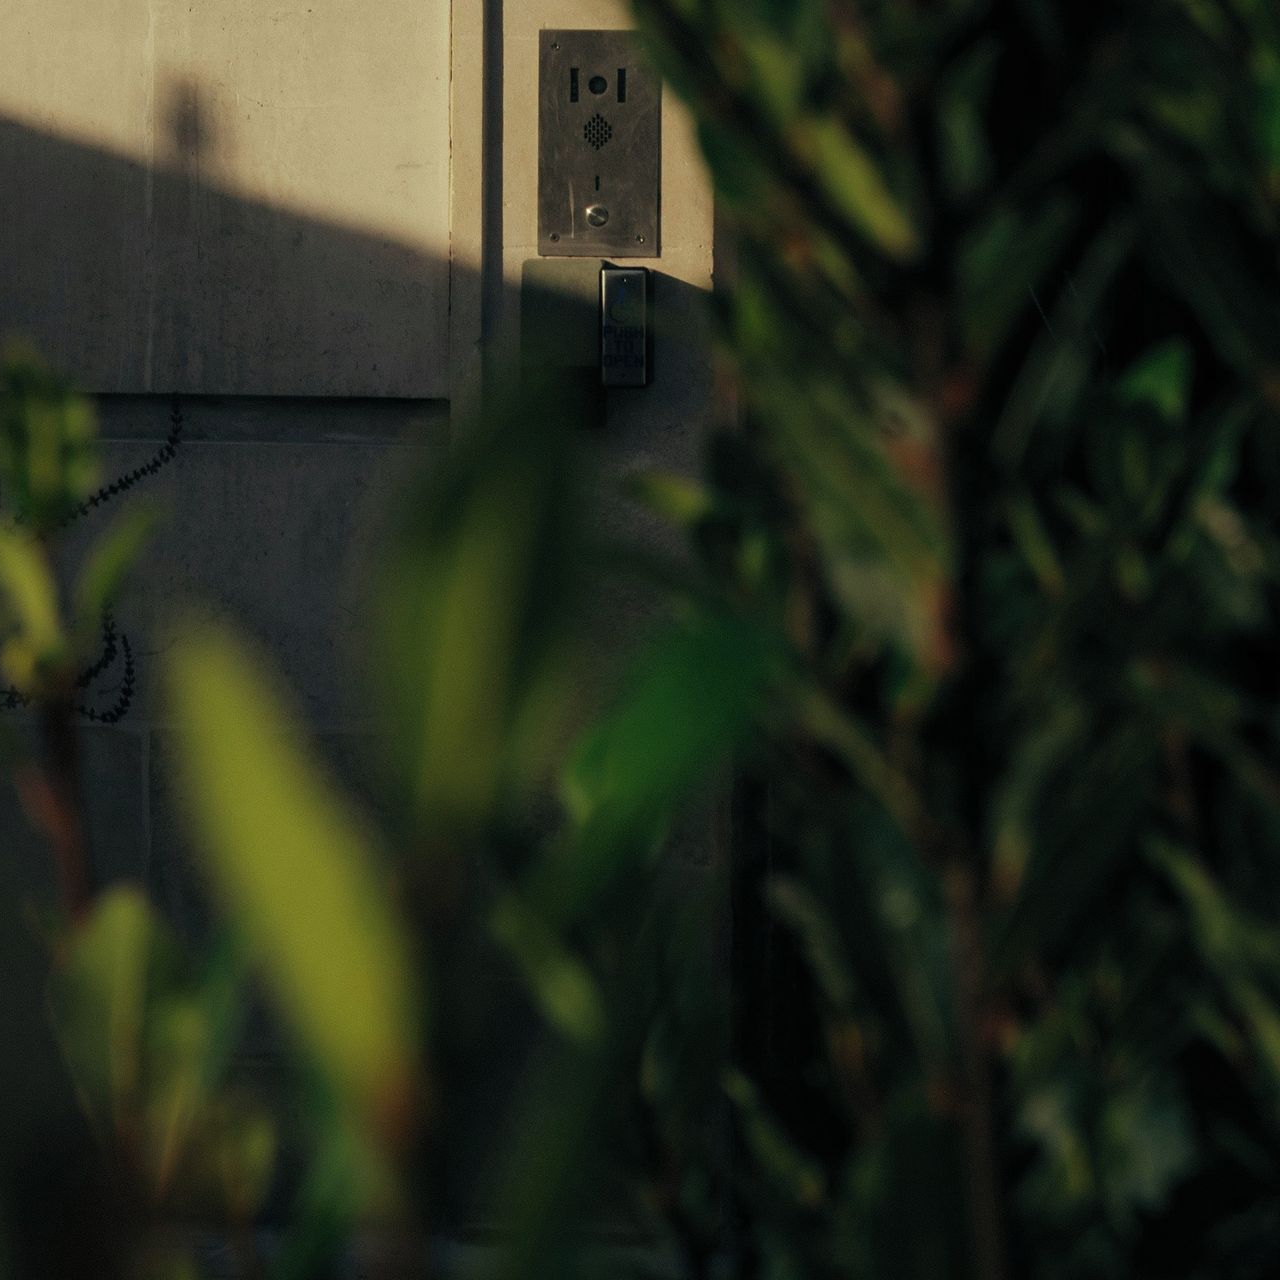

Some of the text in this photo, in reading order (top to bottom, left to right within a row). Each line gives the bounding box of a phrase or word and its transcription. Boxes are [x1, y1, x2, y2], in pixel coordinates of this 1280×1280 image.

[603, 325, 644, 338] PUSH
[613, 340, 634, 352] TO
[603, 354, 644, 367] OPEN
